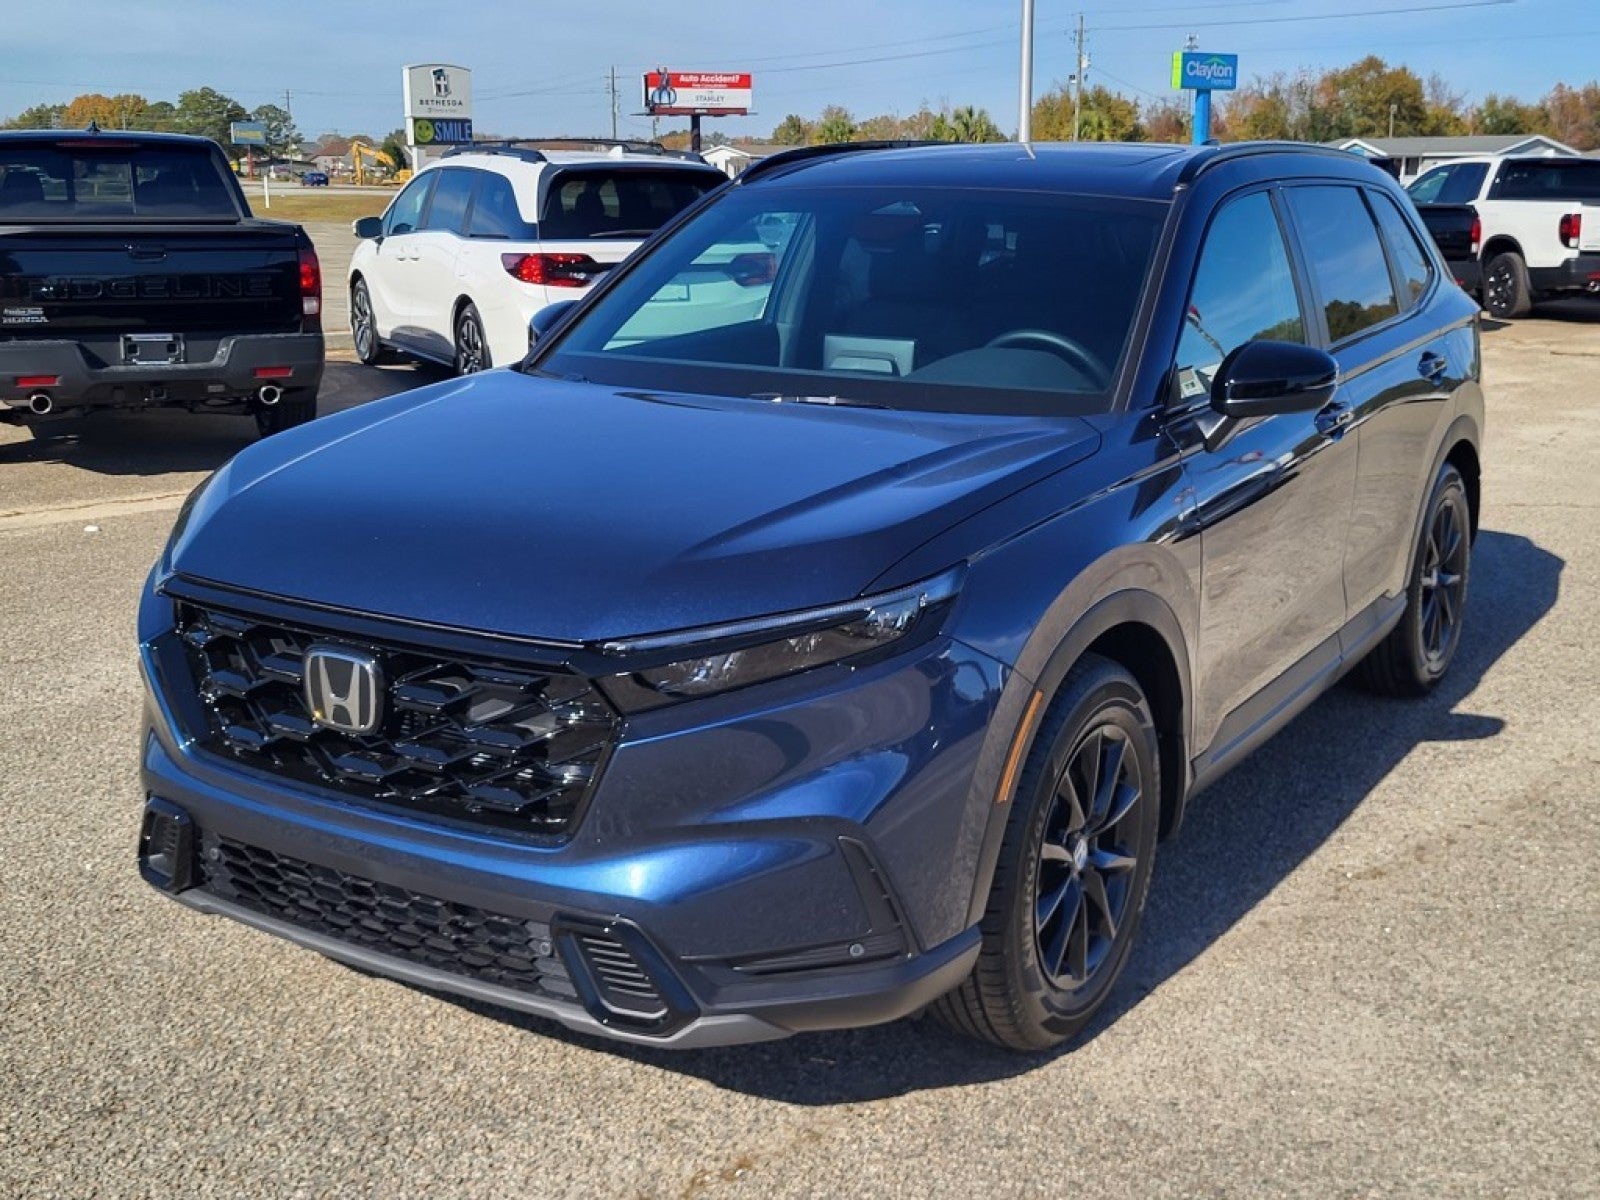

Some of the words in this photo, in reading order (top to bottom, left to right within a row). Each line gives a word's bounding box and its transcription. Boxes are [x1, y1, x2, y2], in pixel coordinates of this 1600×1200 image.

[679, 74, 699, 82] Auto
[700, 74, 739, 83] Accident?
[1186, 61, 1232, 80] Clayton
[419, 99, 463, 107] BETHESDA
[435, 122, 472, 141] SMILE
[27, 274, 273, 299] RIDGELINE
